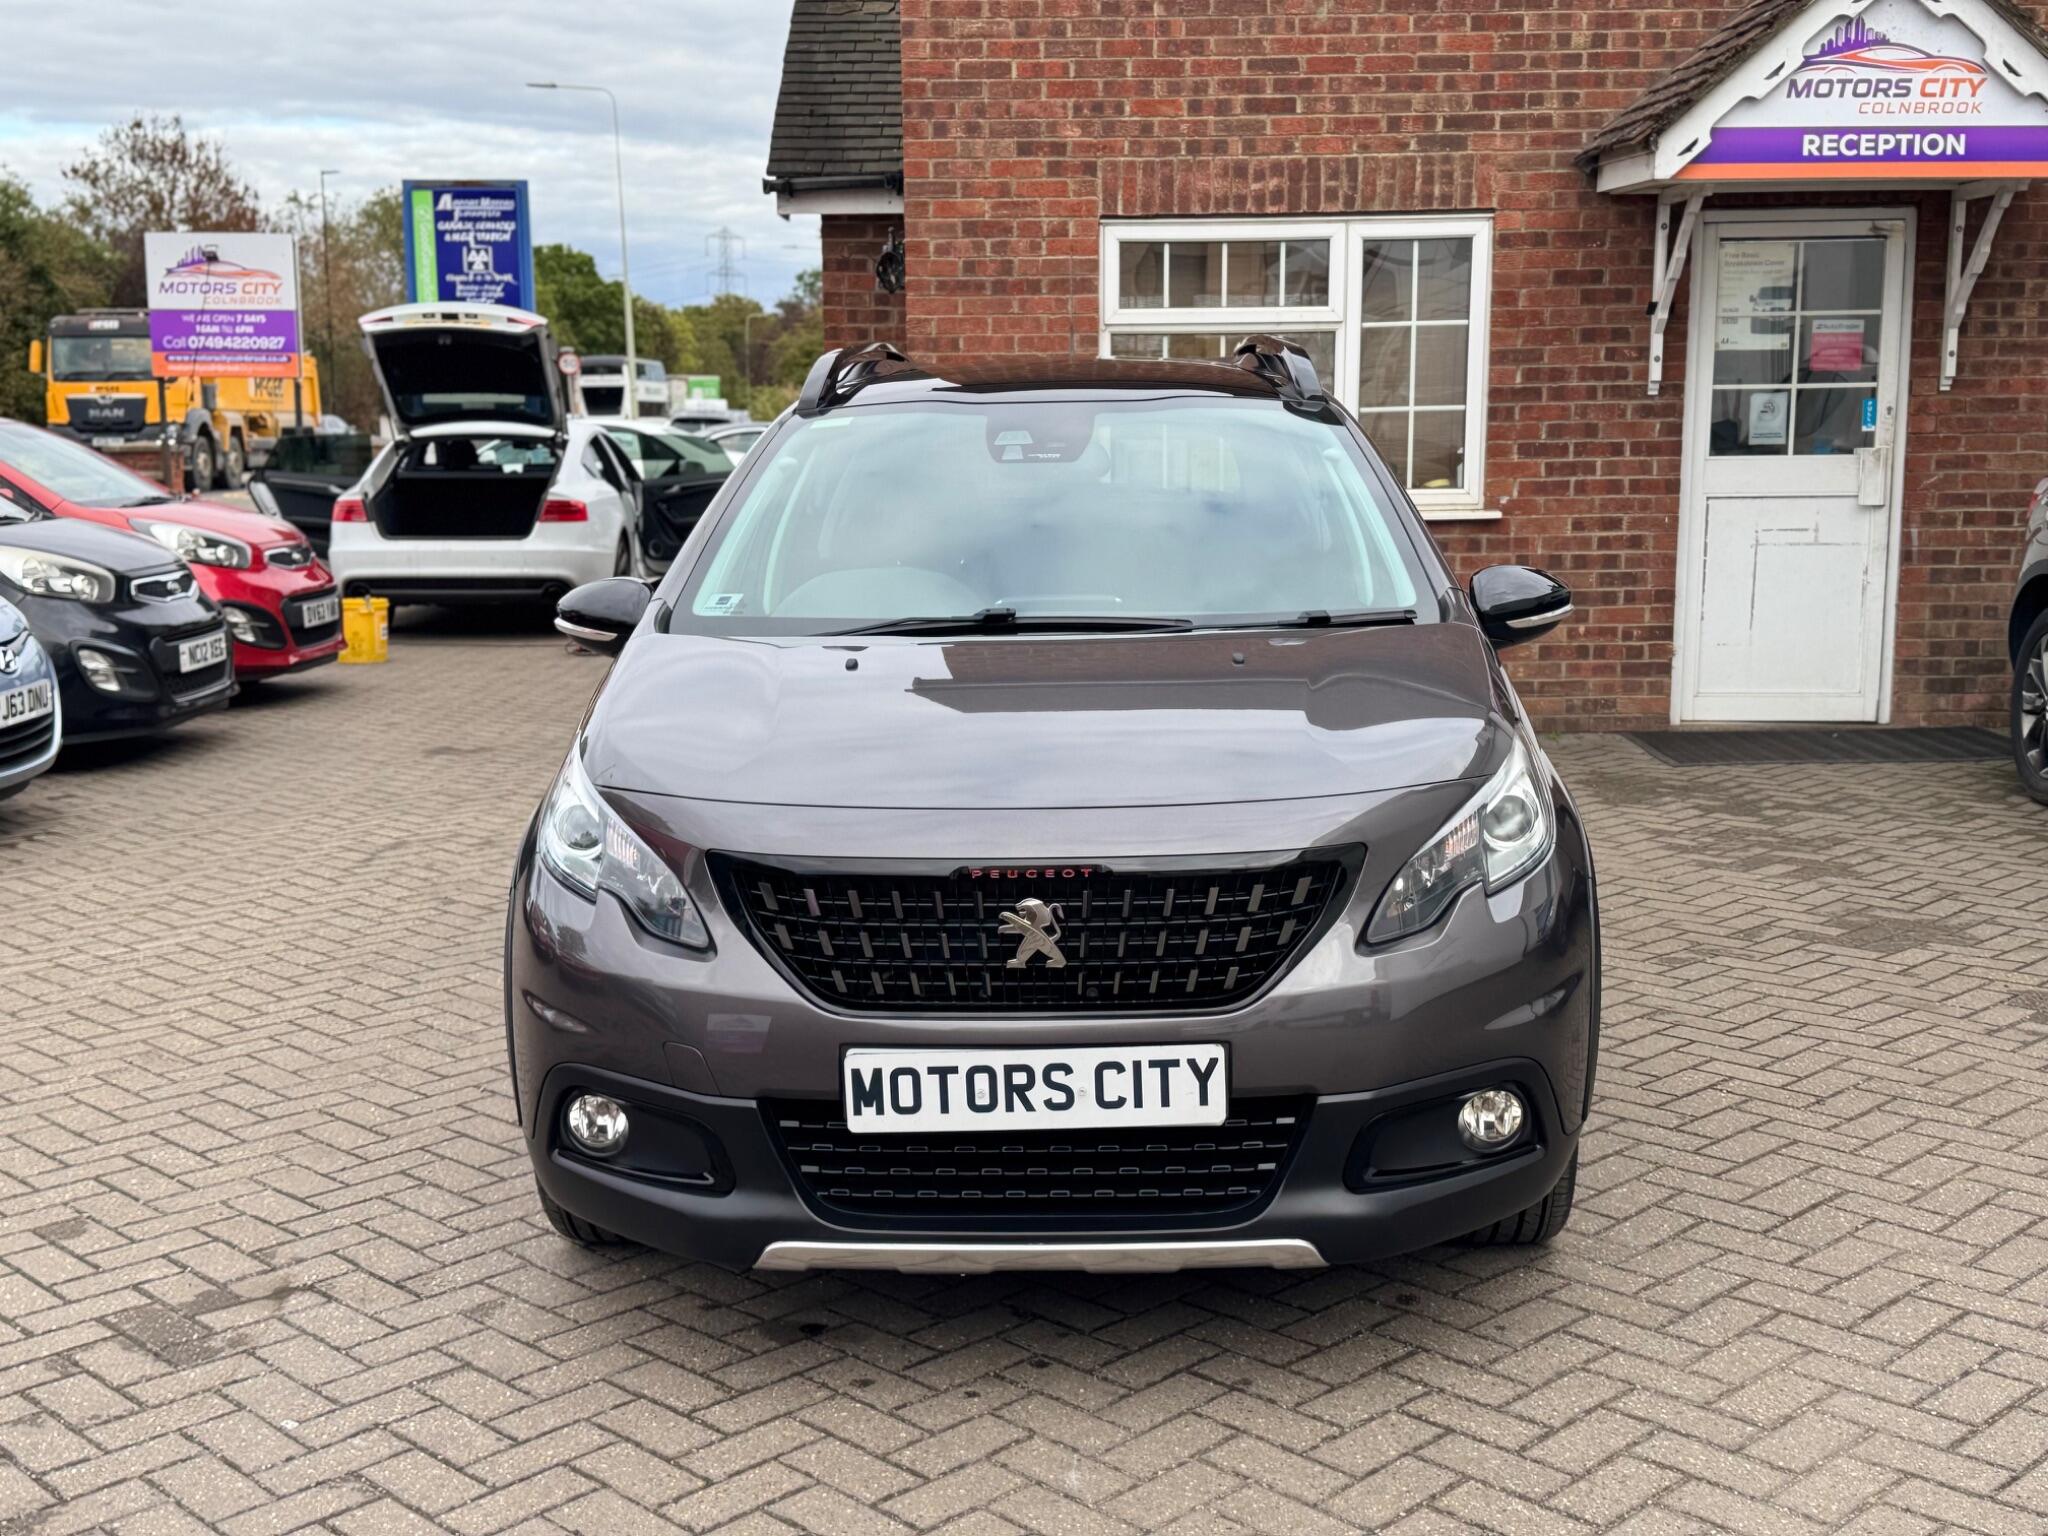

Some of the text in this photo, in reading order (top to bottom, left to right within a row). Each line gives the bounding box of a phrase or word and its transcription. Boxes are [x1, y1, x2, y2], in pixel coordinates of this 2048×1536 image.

[1786, 77, 1988, 99] MOTORS CITY
[1858, 101, 1983, 115] COLNBROOK
[1802, 133, 1966, 157] RECEPTION
[159, 281, 283, 295] MOTORS CITY
[162, 336, 186, 349] Call
[971, 867, 1094, 879] PEUGEOT
[850, 1057, 1219, 1117] MOTORS CITY
